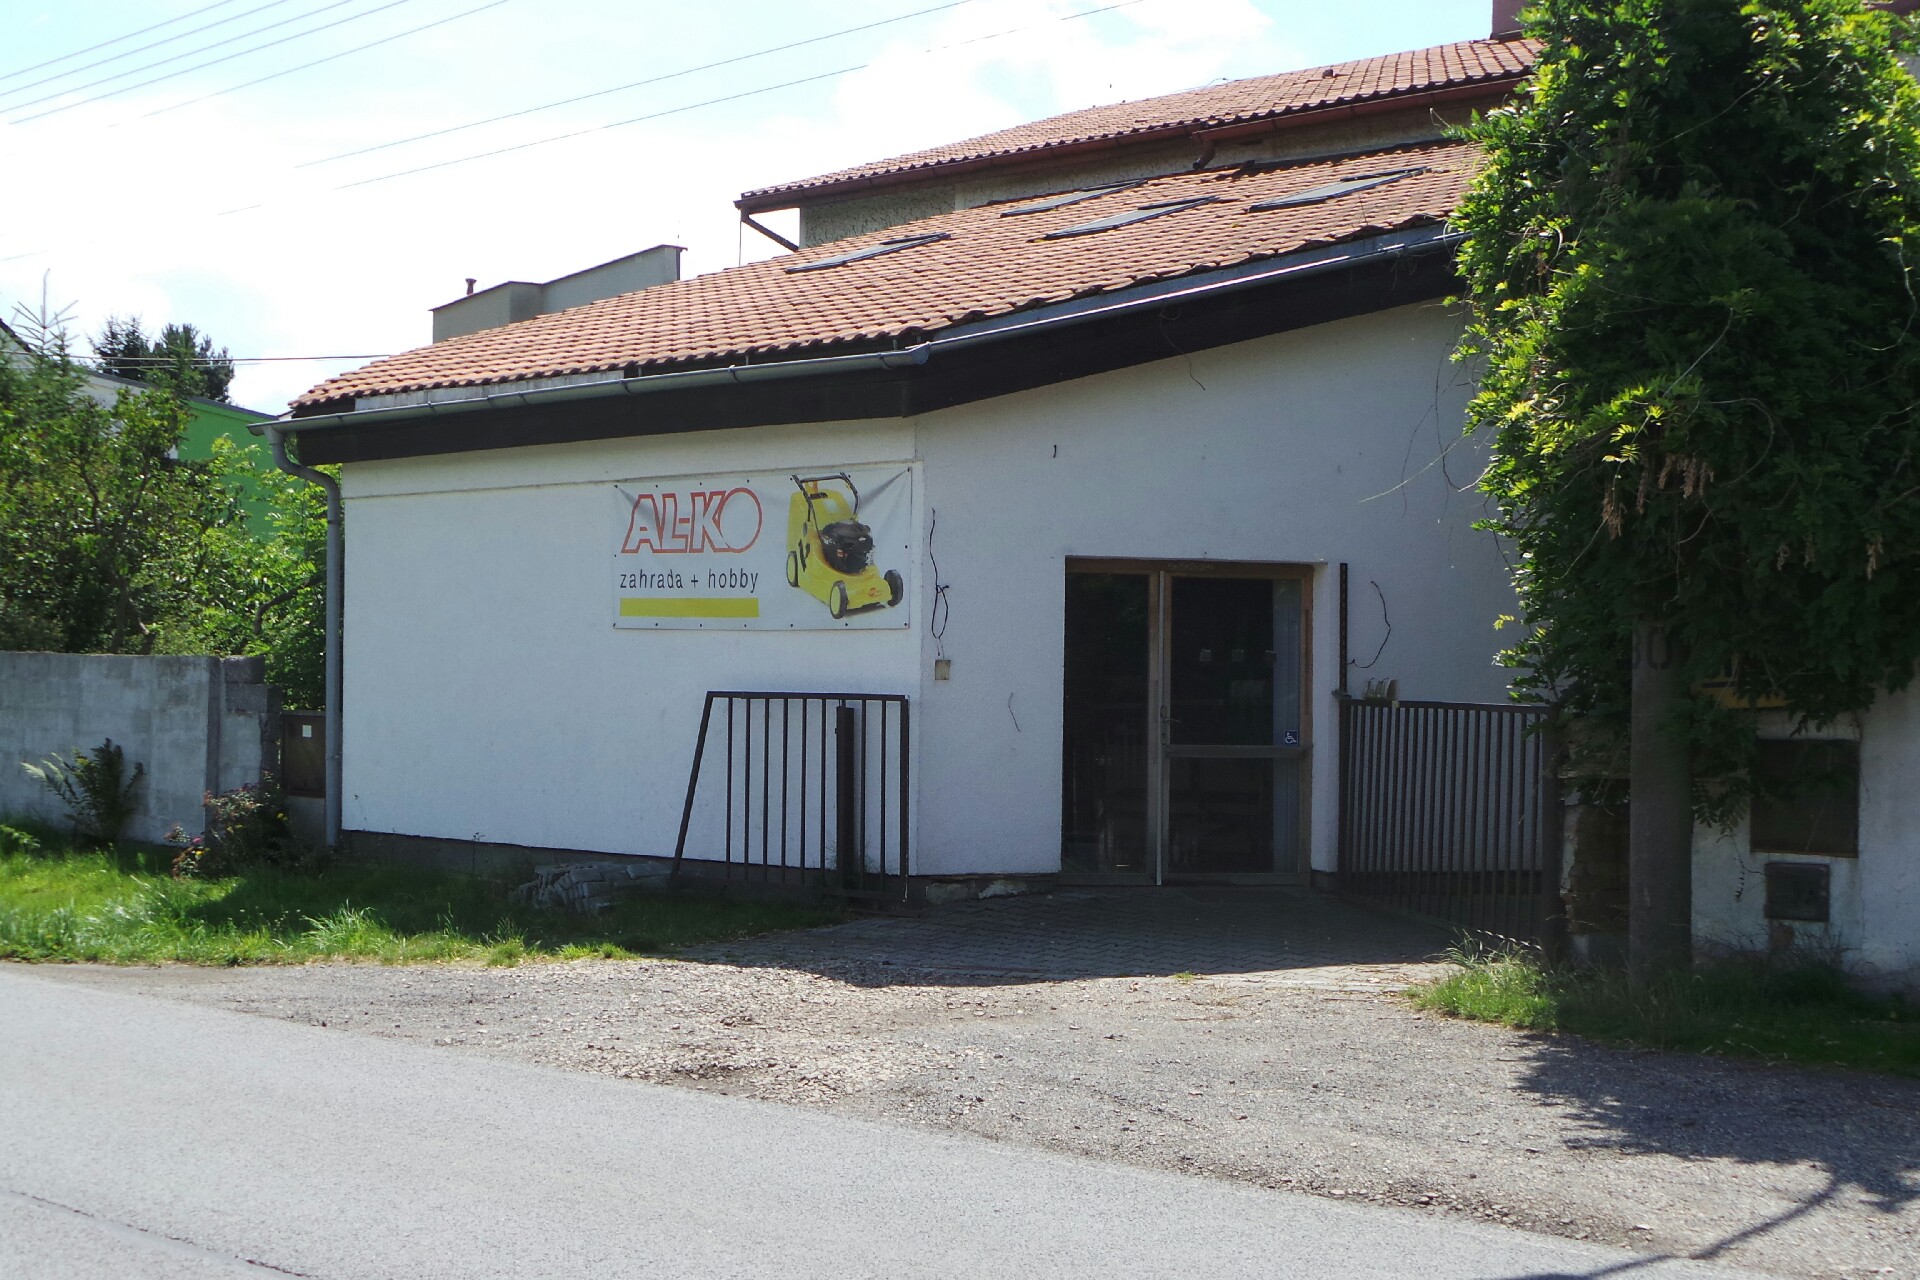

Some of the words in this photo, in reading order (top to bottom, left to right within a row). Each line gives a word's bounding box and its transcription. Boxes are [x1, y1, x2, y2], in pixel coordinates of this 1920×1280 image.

[620, 568, 684, 589] zahrada
[690, 574, 699, 589] +
[708, 567, 759, 594] hobby
